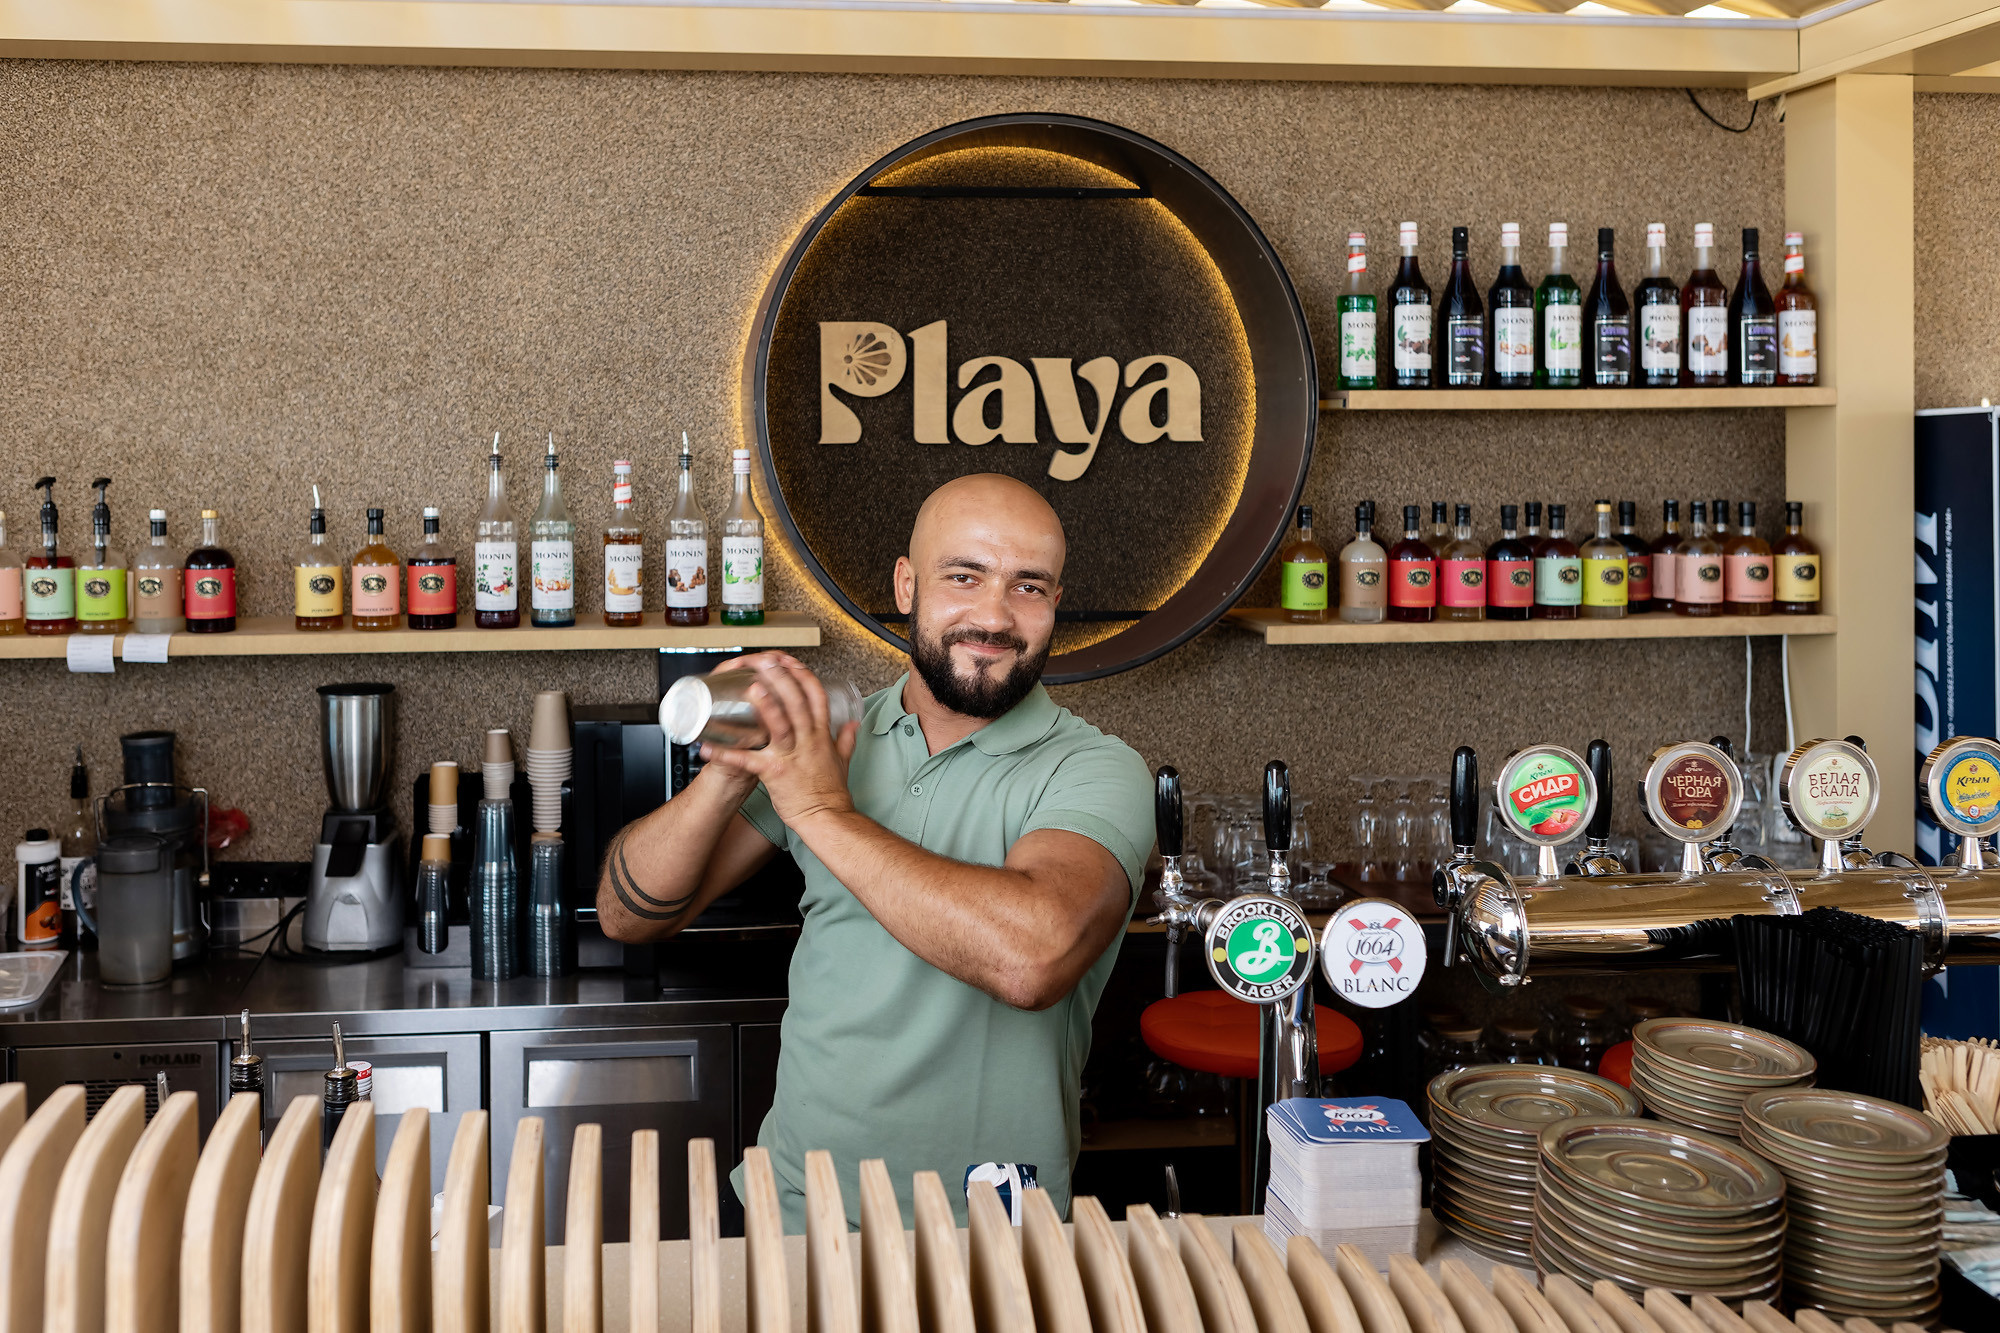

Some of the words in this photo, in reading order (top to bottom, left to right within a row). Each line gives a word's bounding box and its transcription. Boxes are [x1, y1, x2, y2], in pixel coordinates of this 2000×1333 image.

[818, 319, 1205, 482] Playa
[727, 547, 760, 555] MONIN
[1808, 772, 1861, 786] БЕЛАЯ
[1518, 775, 1573, 803] СИДР
[1677, 786, 1713, 798] ГОРА
[1809, 785, 1860, 798] СКАЛА
[1216, 902, 1301, 940] BROOKLYN
[1355, 936, 1397, 956] 1664
[1235, 974, 1296, 998] LAGER
[1343, 976, 1410, 993] BLANC
[139, 1053, 202, 1066] POLAIR
[1326, 1125, 1402, 1134] BLANC
